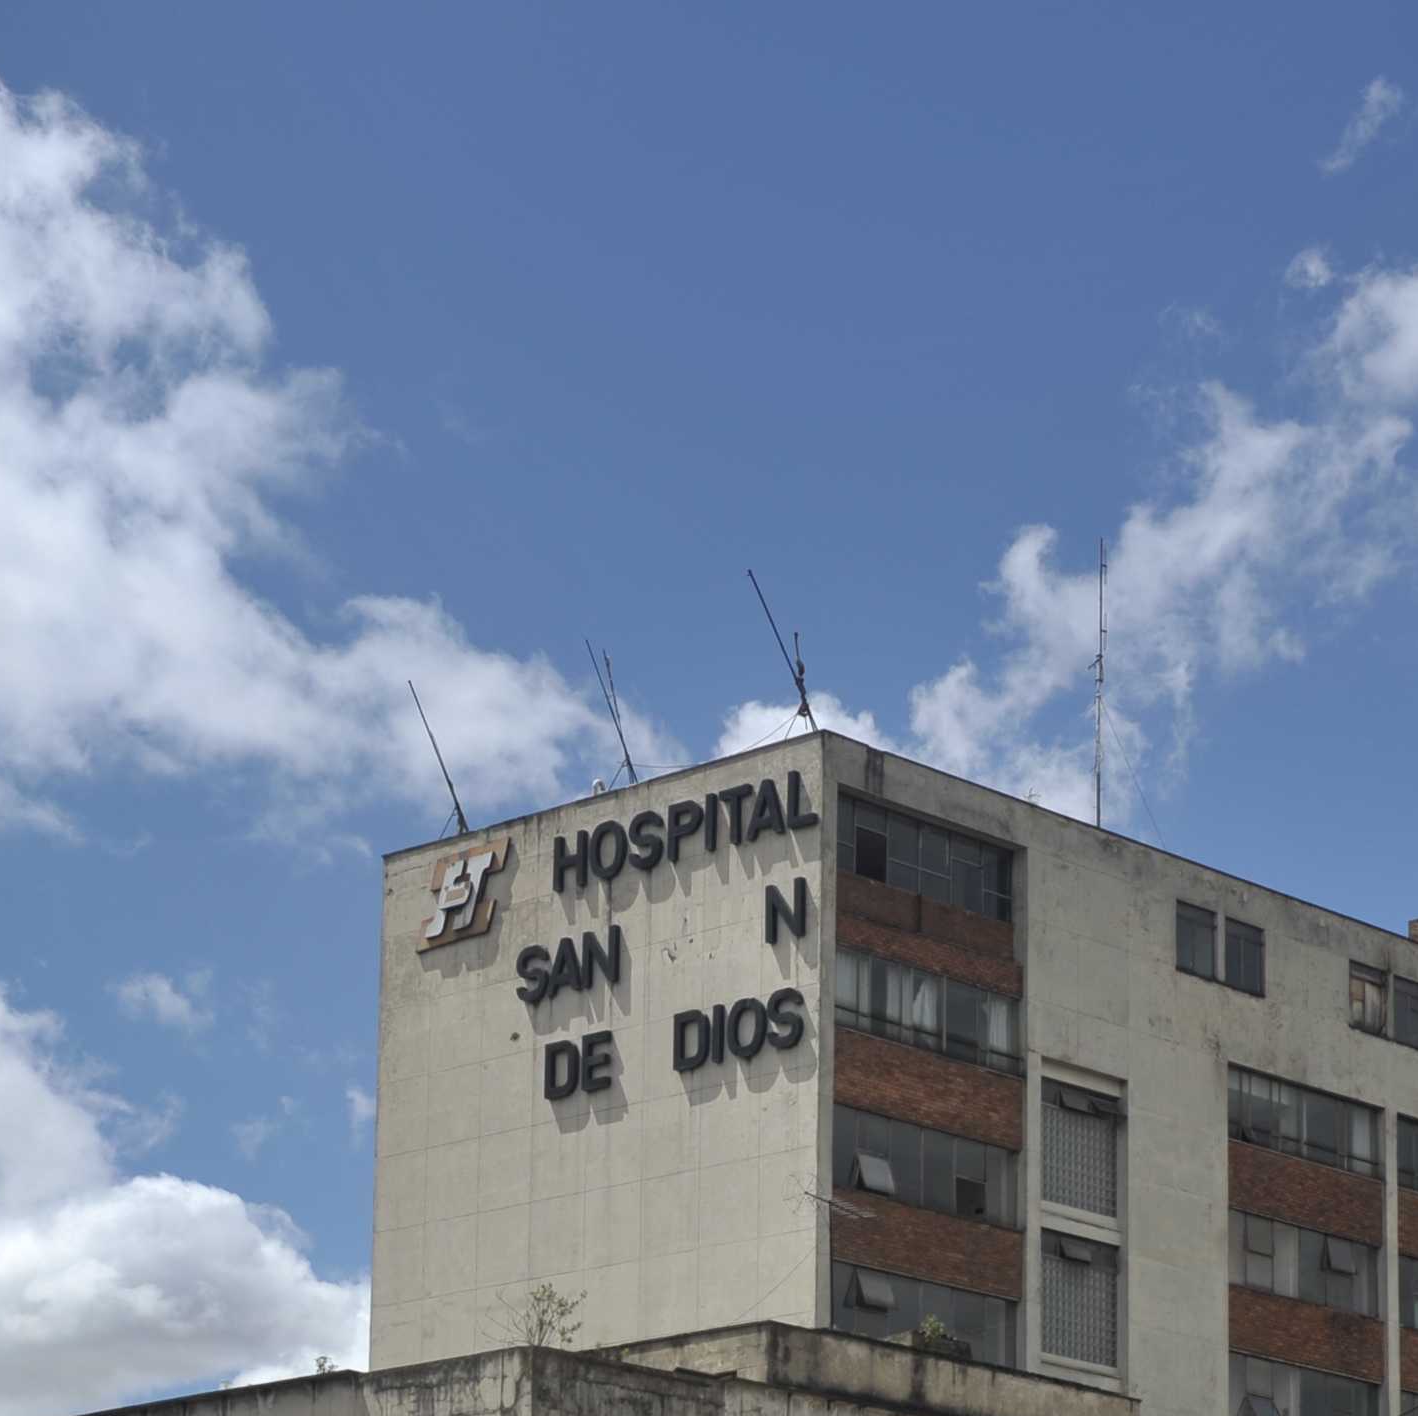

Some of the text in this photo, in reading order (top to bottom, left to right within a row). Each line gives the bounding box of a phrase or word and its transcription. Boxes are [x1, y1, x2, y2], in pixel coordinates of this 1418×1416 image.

[552, 770, 819, 892] HOSPITAL
[516, 924, 620, 1003] SAN
[544, 987, 804, 1101] DE DIOS
